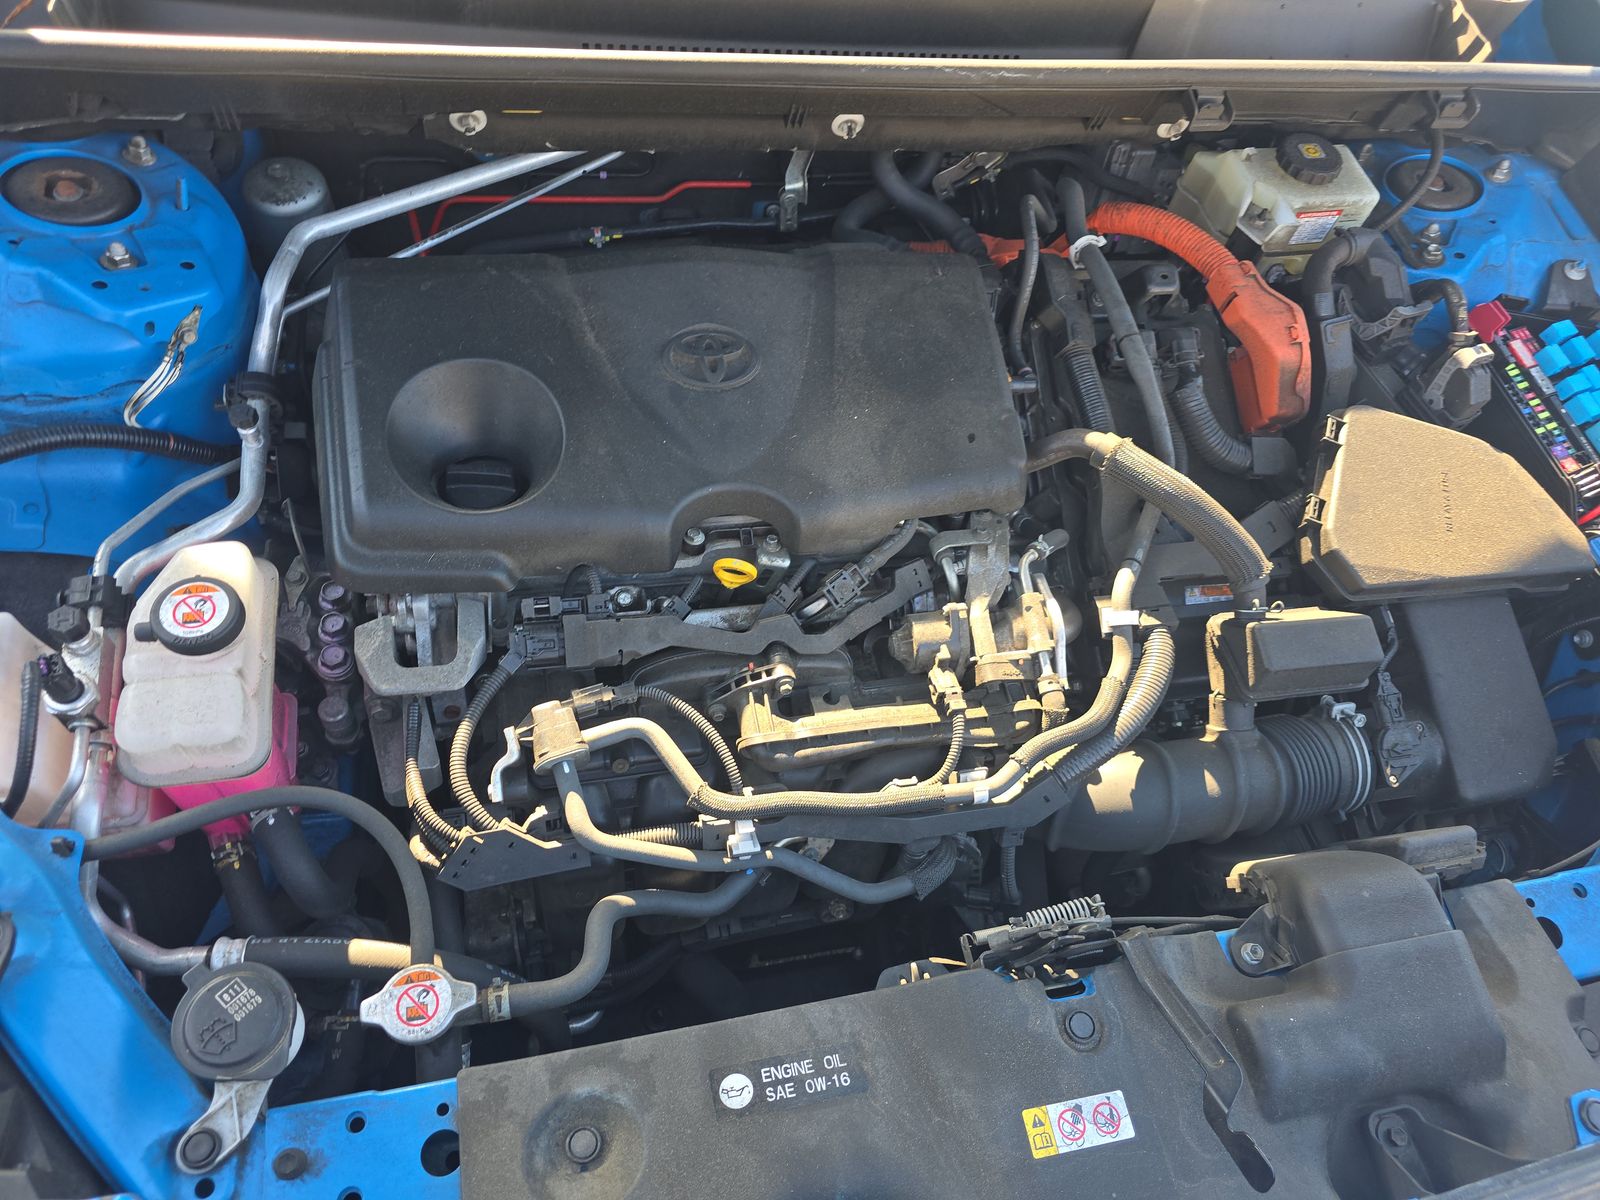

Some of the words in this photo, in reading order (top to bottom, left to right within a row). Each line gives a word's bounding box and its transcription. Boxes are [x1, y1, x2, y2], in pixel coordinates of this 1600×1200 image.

[222, 984, 242, 1002] e11
[761, 1059, 815, 1082] ENGINE
[823, 1053, 847, 1069] OIL
[765, 1083, 797, 1102] SAE
[805, 1072, 850, 1094] 0W-16
